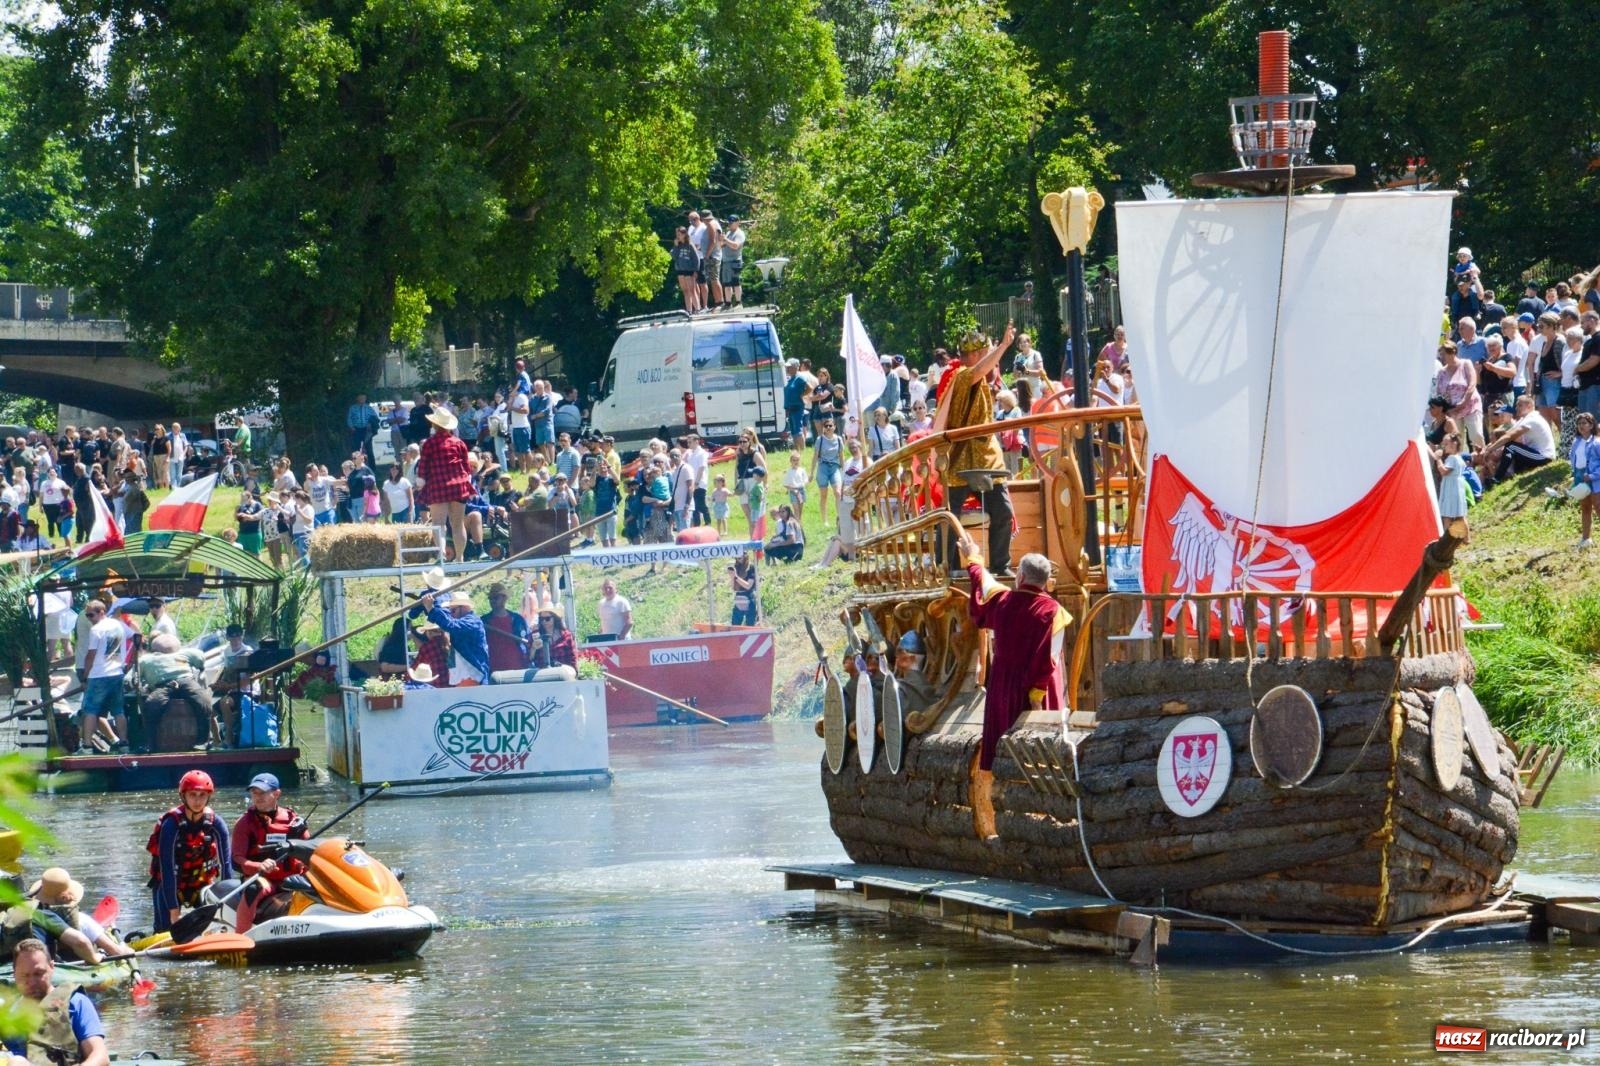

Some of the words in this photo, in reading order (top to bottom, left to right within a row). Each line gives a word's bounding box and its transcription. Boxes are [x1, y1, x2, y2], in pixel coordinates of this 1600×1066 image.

[591, 551, 657, 566] KONTENER
[661, 545, 740, 561] POMOCOWY
[651, 650, 698, 664] KONIEC
[438, 710, 537, 735] ROLNIK
[447, 734, 531, 754] SZUKA
